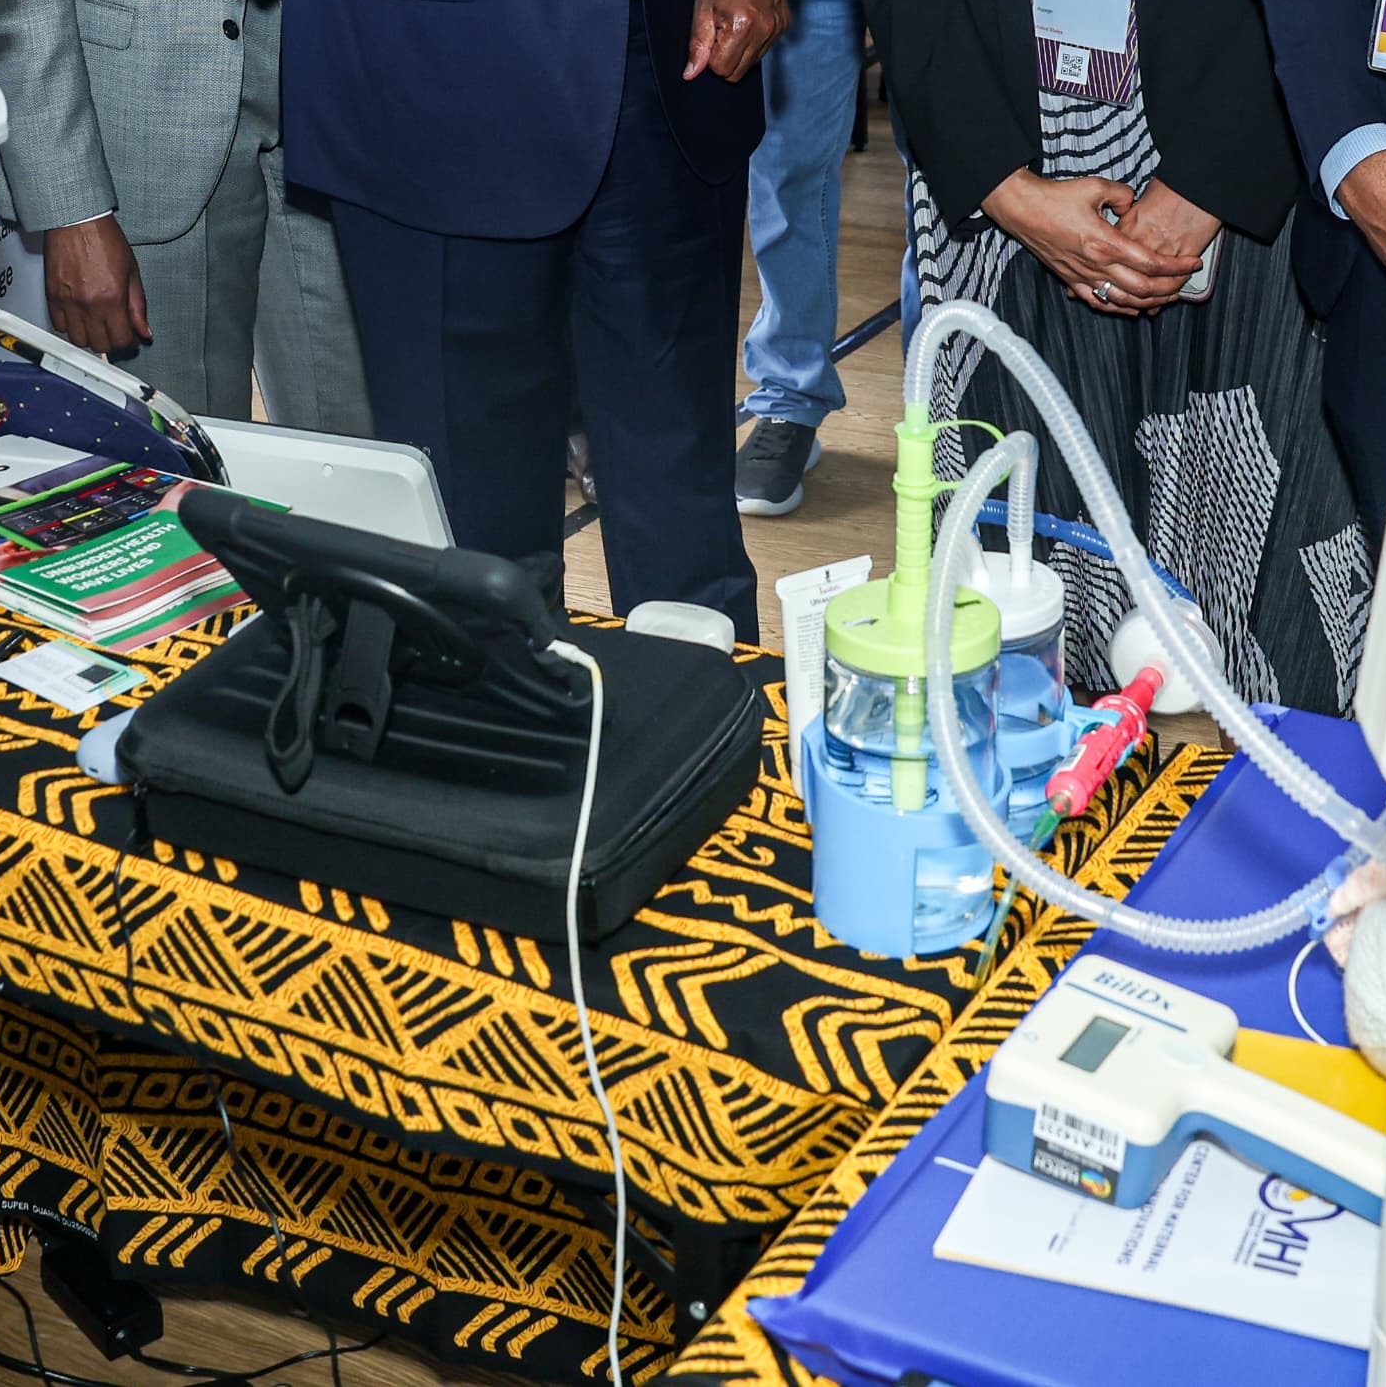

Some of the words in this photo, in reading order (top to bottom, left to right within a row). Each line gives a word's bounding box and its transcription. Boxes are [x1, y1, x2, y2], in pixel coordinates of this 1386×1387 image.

[40, 545, 121, 578] UNBURDEN
[120, 523, 177, 550] HEALTH
[54, 556, 129, 584] WORKERS
[129, 541, 162, 559] AND
[71, 575, 113, 591] SAVE
[113, 557, 154, 579] LIVES
[1094, 971, 1171, 1011] BiliDx
[1, 1200, 29, 1211] SUPER
